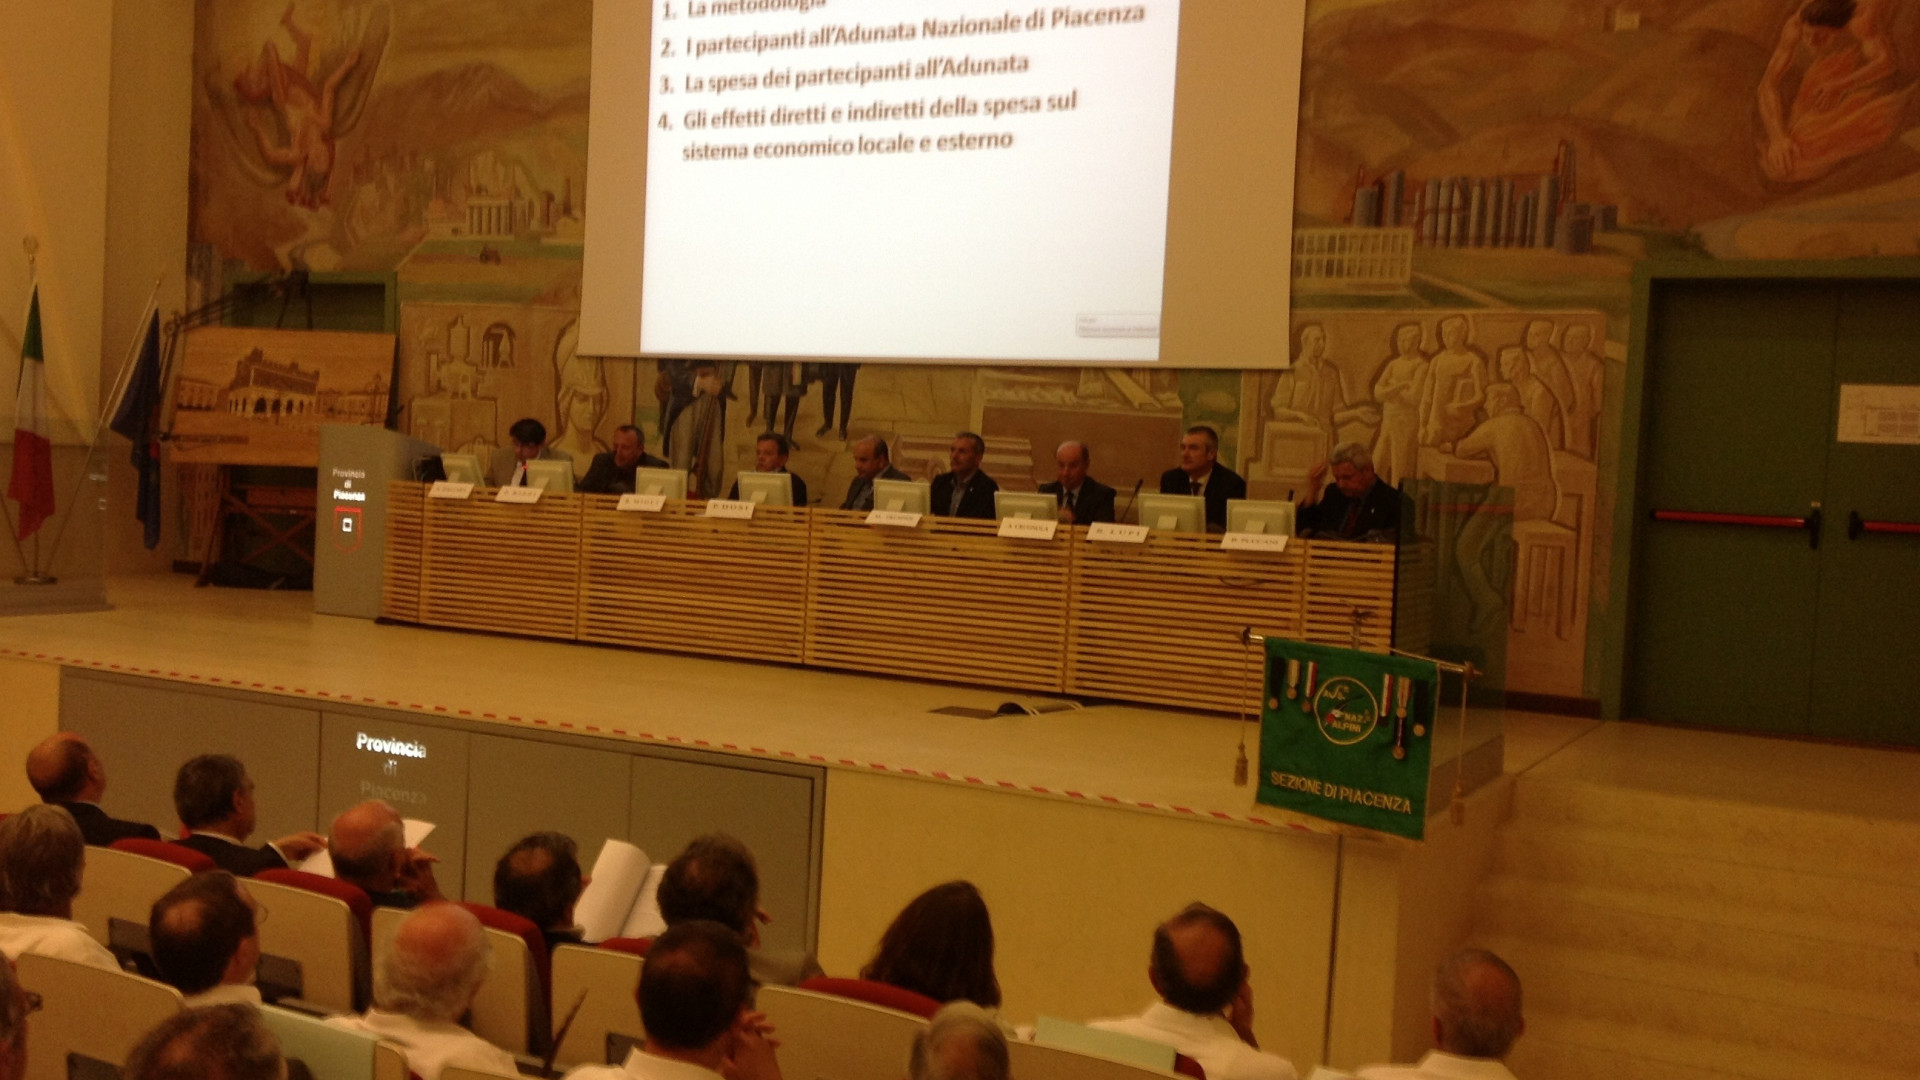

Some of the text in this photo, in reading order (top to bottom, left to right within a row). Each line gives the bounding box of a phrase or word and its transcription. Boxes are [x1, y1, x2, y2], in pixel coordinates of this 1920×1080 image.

[662, 0, 827, 20] 1. La metodologia
[661, 38, 676, 57] 2.
[687, 36, 692, 56] I
[696, 30, 805, 59] partecipanti
[922, 13, 1021, 39] Nazionale
[1025, 8, 1045, 30] di
[1051, 4, 1146, 28] Piacenza
[659, 74, 675, 94] 3.
[685, 75, 704, 93] La
[708, 74, 758, 95] spesa
[762, 68, 790, 88] dei
[795, 58, 911, 91] partecipanti
[657, 87, 1078, 131] 4. Gli effetti diretti e indiretti della spesa sul
[682, 130, 1014, 161] sistema economico locale e esterno
[332, 468, 366, 479] Provincia
[344, 479, 352, 489] di
[356, 731, 427, 759] Provincia
[383, 759, 398, 776] di
[360, 780, 428, 805] Piacenza
[1271, 771, 1412, 815] SEZIONE DI PIACENZA
